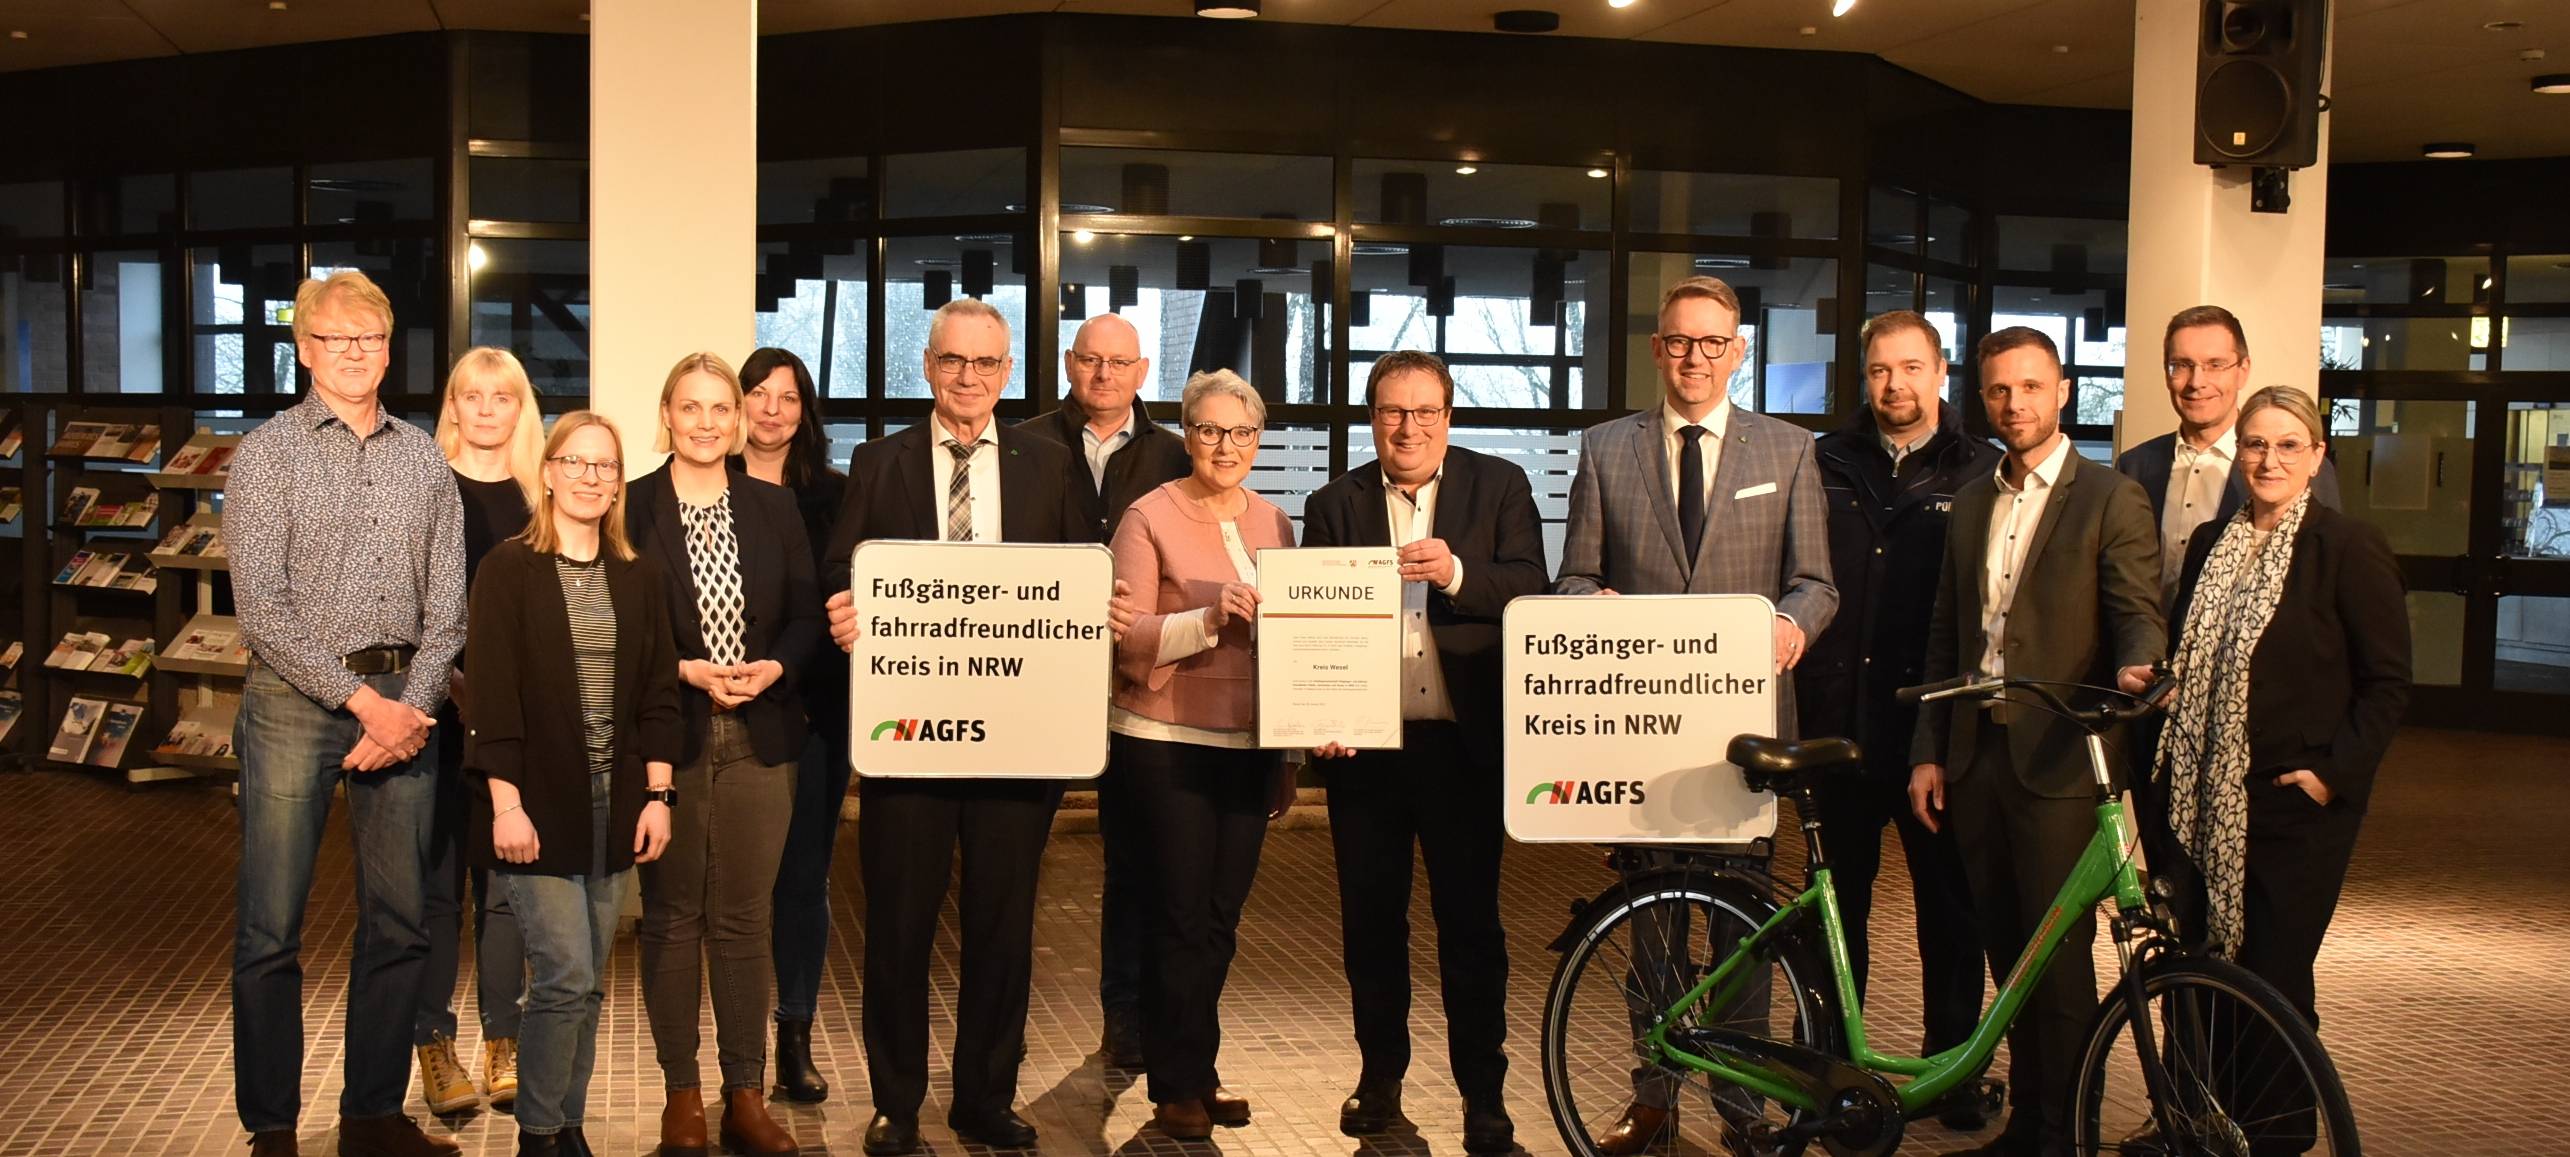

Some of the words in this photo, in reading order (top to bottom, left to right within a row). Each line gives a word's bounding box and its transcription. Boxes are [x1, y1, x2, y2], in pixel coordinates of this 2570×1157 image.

[872, 577, 1009, 604] Fußgänger-
[1017, 580, 1060, 601] und
[1289, 586, 1374, 600] URKUNDE
[870, 615, 1105, 640] fahrradfreundlicher
[1525, 633, 1665, 660] Fußgänger-
[1673, 632, 1718, 654] und
[871, 654, 931, 676] Kreis
[938, 655, 959, 676] in
[968, 656, 1024, 677] NRW
[1523, 672, 1766, 695] fahrradfreundlicher
[918, 719, 986, 742] AGFS
[1525, 713, 1587, 735] Kreis
[1594, 713, 1616, 735] in
[1624, 714, 1683, 735] NRW
[1575, 780, 1646, 804] AGFS
